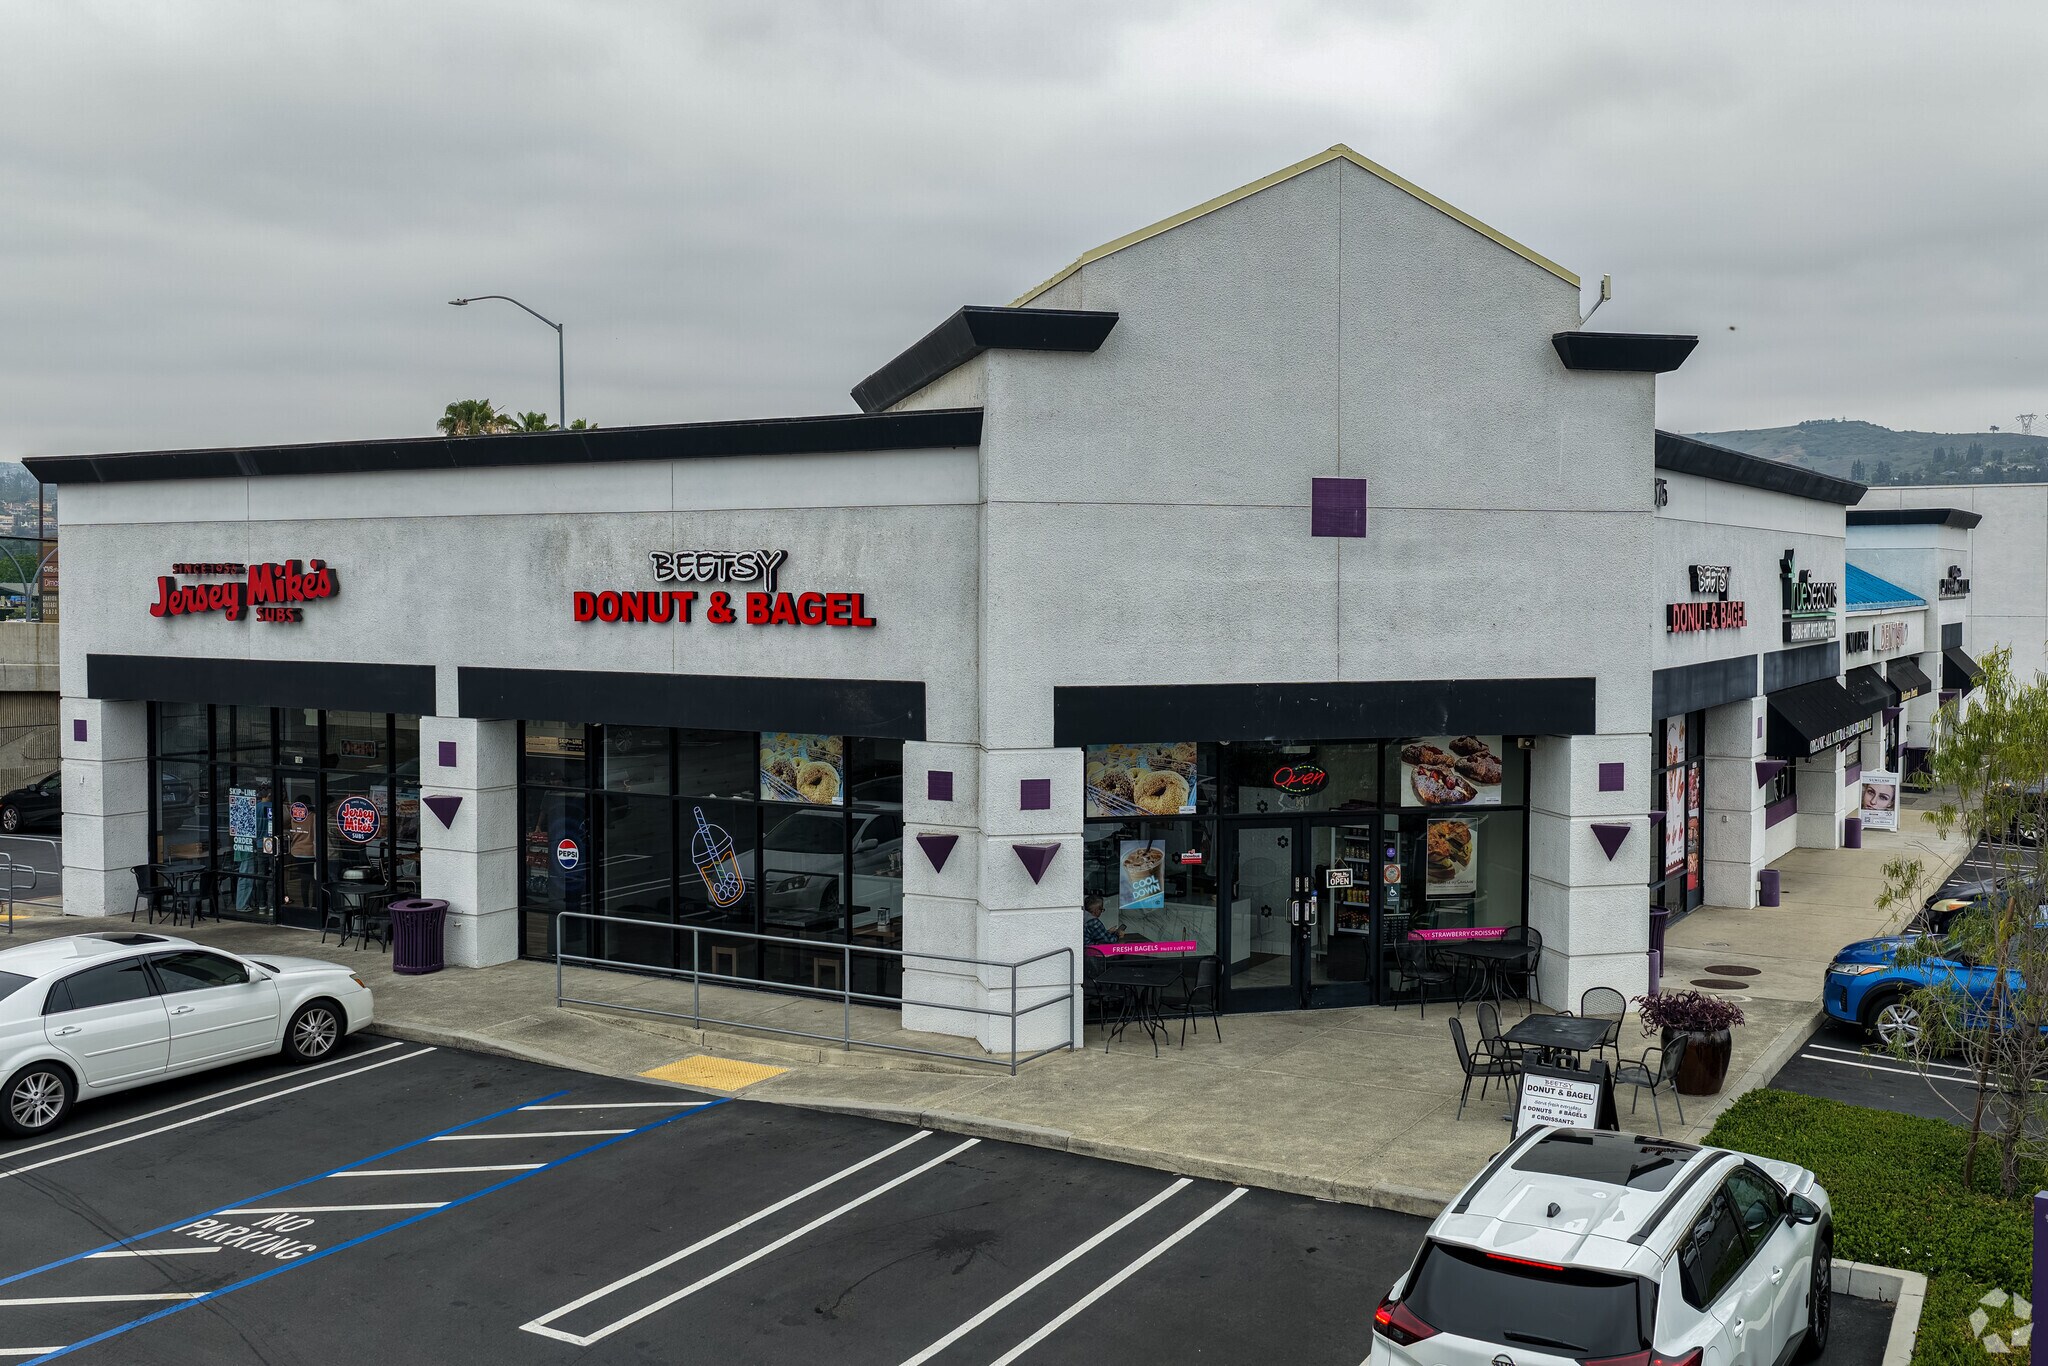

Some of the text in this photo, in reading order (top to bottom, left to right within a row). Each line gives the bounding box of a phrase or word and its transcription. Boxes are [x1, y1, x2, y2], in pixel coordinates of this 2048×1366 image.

[173, 564, 207, 574] SINCE
[649, 550, 784, 593] BEETSY
[150, 559, 332, 622] Jersey Mike's
[256, 607, 296, 622] SUBS
[573, 591, 876, 627] DONUT & BAGEL
[1673, 601, 1747, 632] DONUT & BAGEL
[1273, 767, 1326, 787] Open
[342, 804, 374, 822] Jersey
[344, 816, 374, 833] Mike's
[233, 844, 254, 852] ONLINE
[1133, 875, 1158, 889] COOL
[1330, 877, 1349, 885] OPEN
[1133, 884, 1160, 899] DOWN
[1431, 930, 1471, 938] STRAWBERRY
[1527, 1084, 1556, 1094] DONUT
[1566, 1090, 1593, 1100] BAGEL
[1545, 1080, 1573, 1089] BEETSY
[1527, 1106, 1552, 1114] DONUTS
[1536, 1114, 1574, 1125] CROISSANTS
[251, 1212, 315, 1233] NO
[172, 1218, 317, 1260] PARKING
